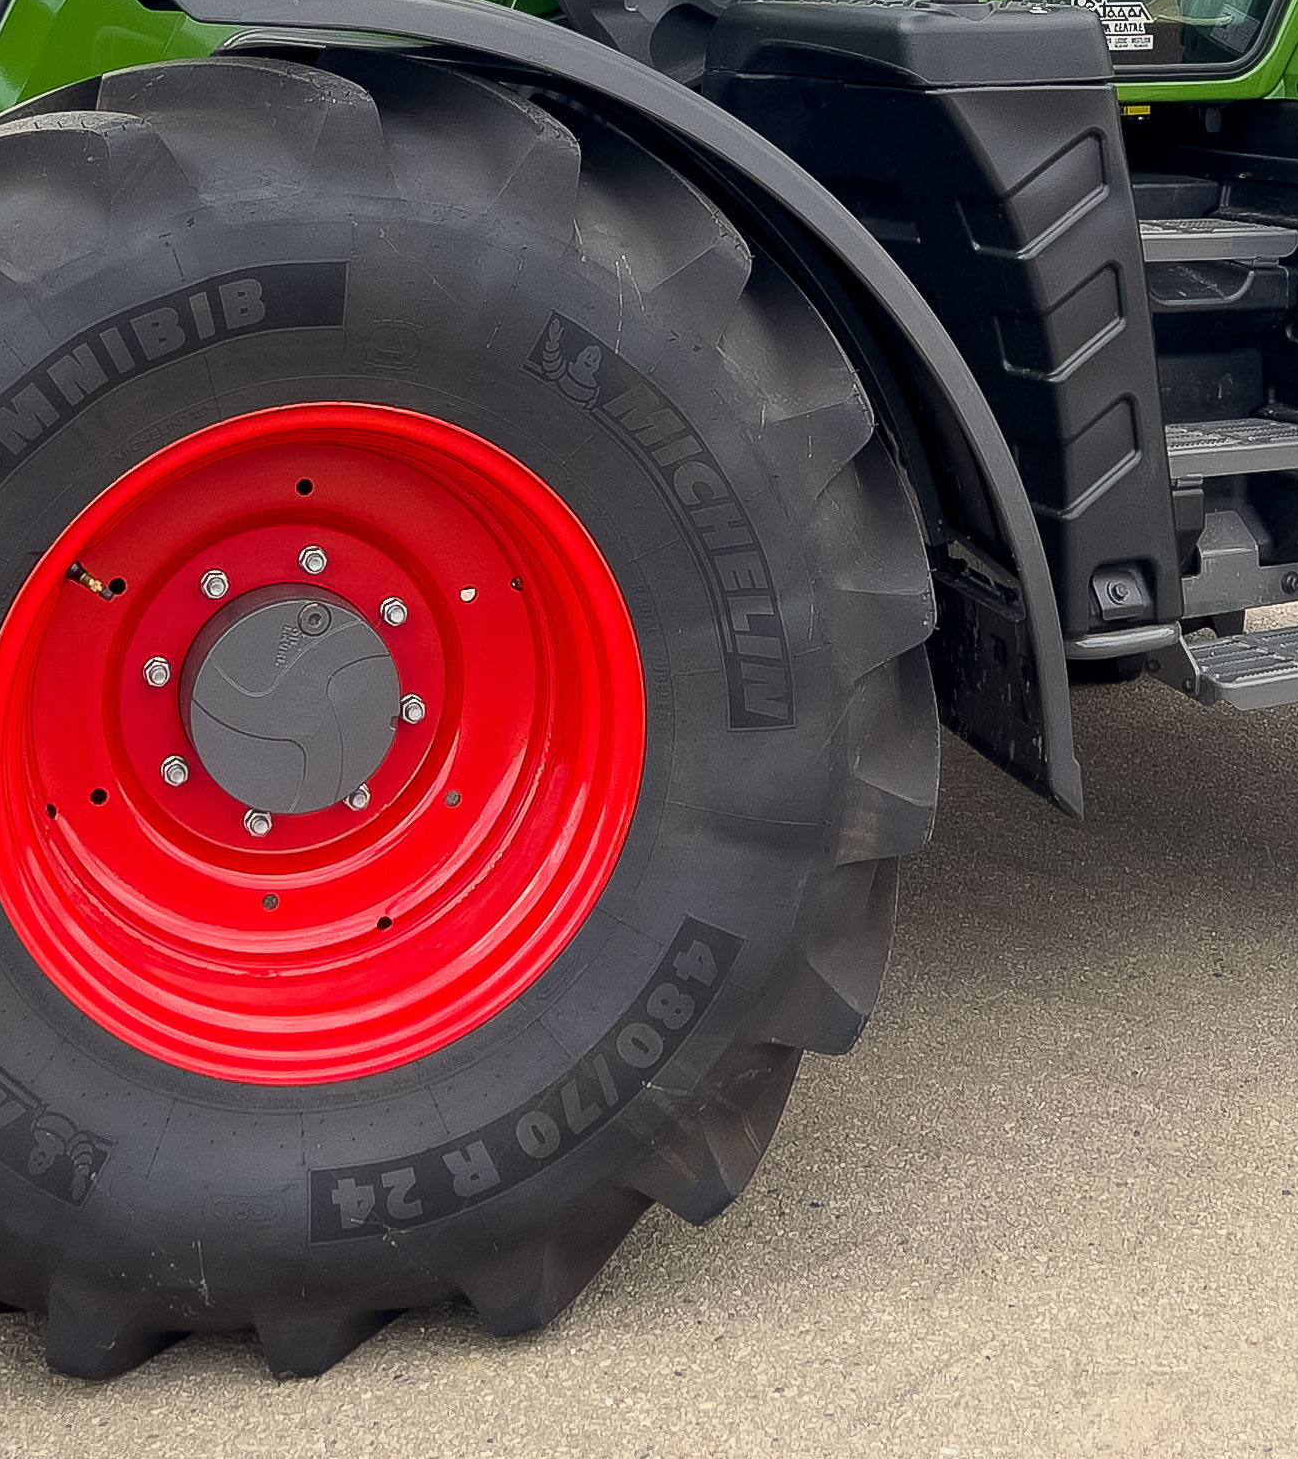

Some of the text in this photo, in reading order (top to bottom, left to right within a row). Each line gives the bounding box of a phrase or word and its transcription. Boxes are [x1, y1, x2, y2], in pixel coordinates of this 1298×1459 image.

[604, 383, 788, 720] MICHELIN
[515, 940, 718, 1159] 480/70
[331, 1167, 423, 1229] 24
[442, 1140, 501, 1198] R
